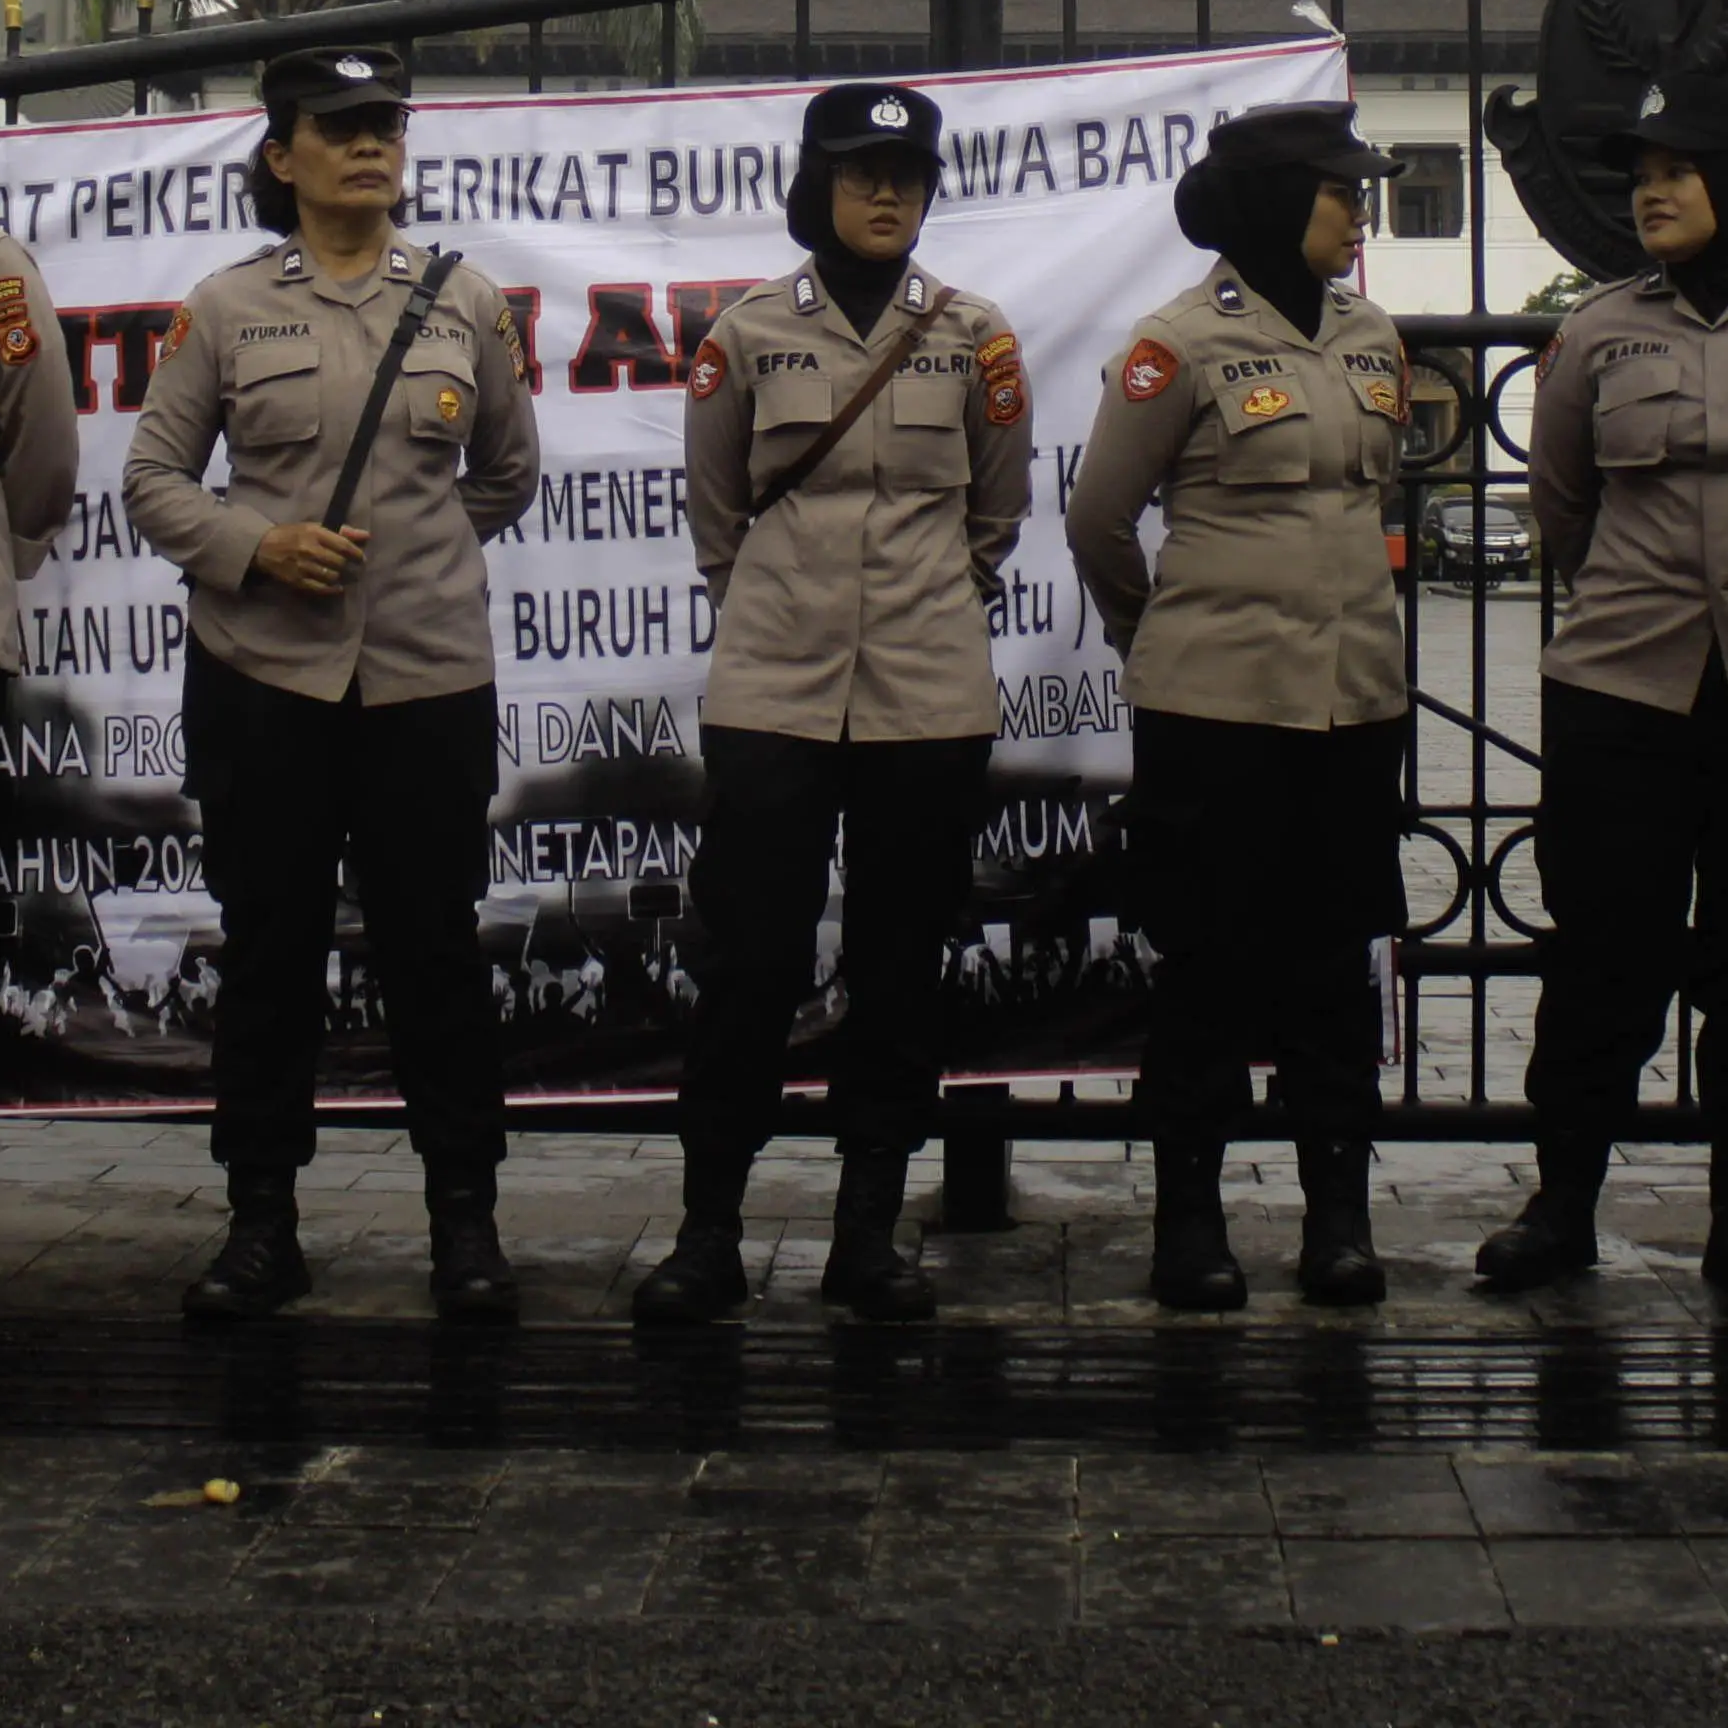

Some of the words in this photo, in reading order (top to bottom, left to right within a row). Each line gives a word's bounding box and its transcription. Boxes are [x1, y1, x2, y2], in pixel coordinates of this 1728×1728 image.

[412, 152, 630, 224] ERIKAT
[238, 321, 312, 344] AYURAKA
[756, 350, 819, 375] EFFA
[898, 352, 972, 376] POLRI
[1342, 353, 1395, 375] POLRI
[1603, 341, 1671, 365] MARINI
[1221, 356, 1284, 382] DEWI
[513, 586, 672, 661] BURUH
[537, 696, 684, 765] DANA
